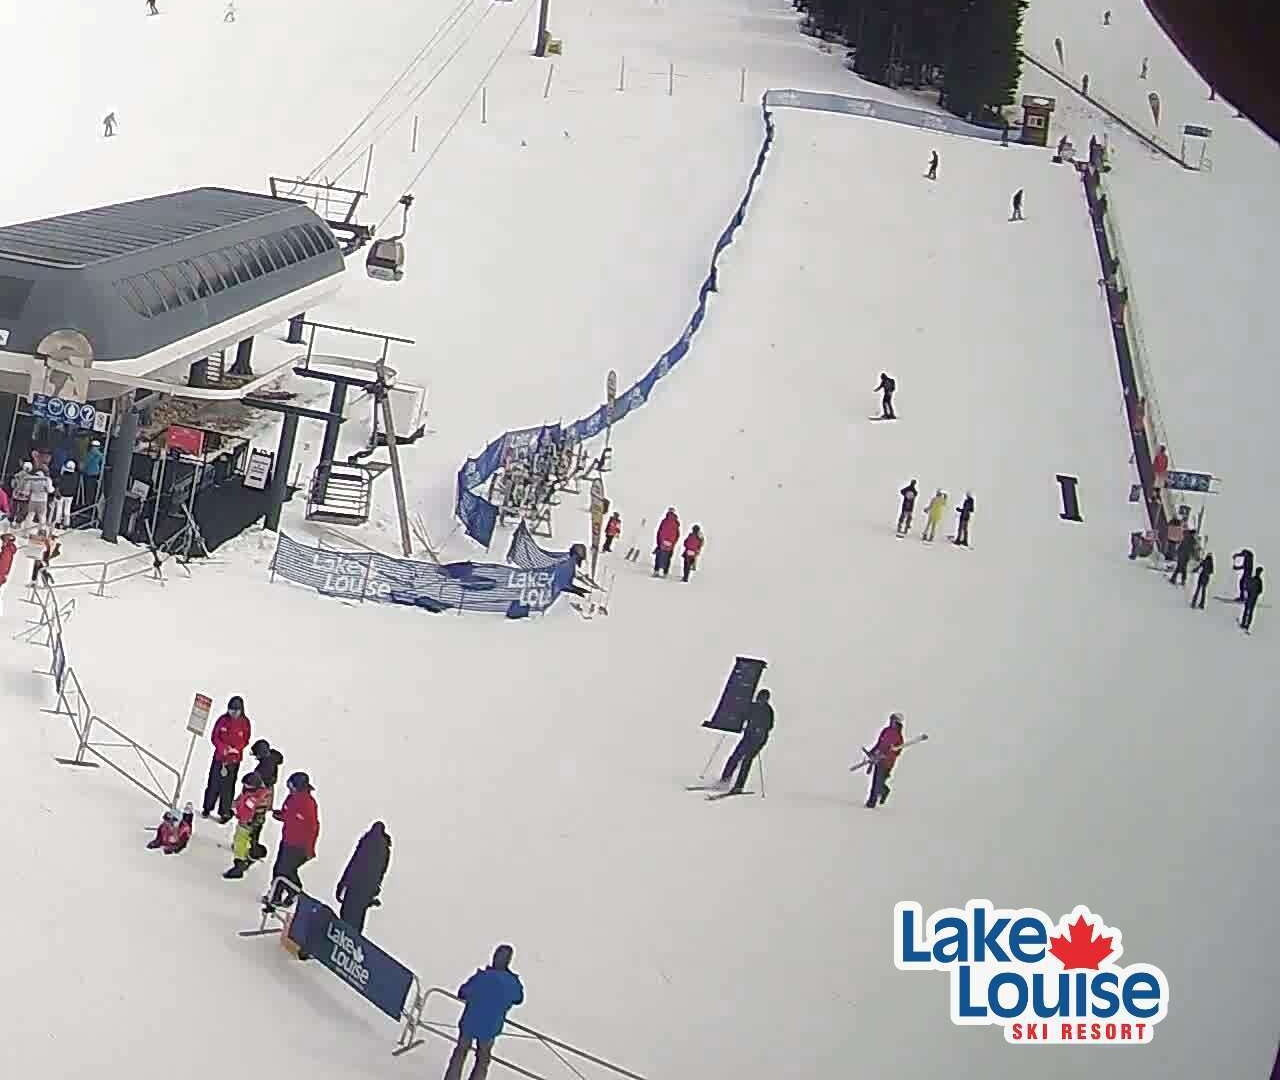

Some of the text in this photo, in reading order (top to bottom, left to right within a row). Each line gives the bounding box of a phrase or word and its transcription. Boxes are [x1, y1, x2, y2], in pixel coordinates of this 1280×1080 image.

[508, 571, 549, 588] Lake
[327, 922, 355, 954] Lake
[330, 944, 369, 985] Louise
